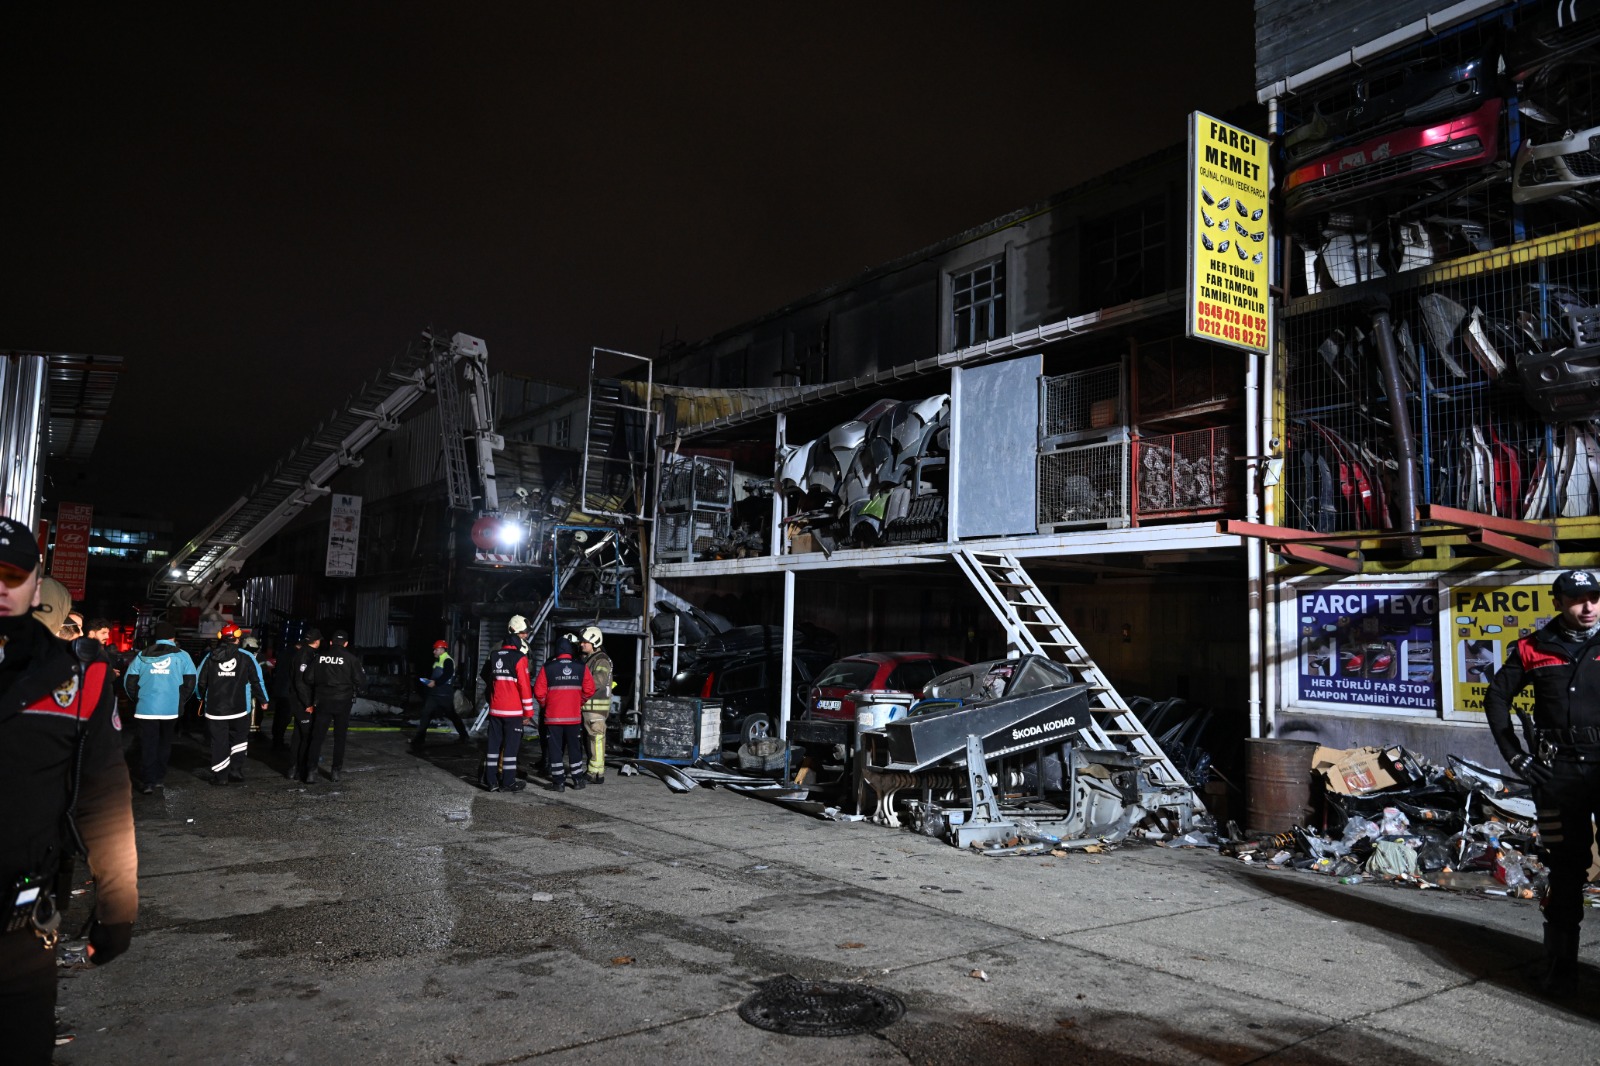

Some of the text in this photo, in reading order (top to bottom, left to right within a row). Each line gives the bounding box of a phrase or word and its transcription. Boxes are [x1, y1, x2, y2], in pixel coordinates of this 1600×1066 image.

[1210, 121, 1256, 157] FARCI
[1205, 144, 1260, 182] MEMET
[1235, 180, 1251, 193] YEDEK
[1210, 259, 1255, 282] HER TÜRLÜ
[1206, 273, 1258, 298] FAR TAMPON
[1200, 285, 1265, 314] TAMİRİ YAPILIR
[1198, 300, 1266, 332] 0545 473 40 52
[1198, 317, 1221, 336] 0212
[1223, 324, 1240, 341] 485
[1255, 332, 1266, 348] 27
[1301, 594, 1439, 615] FARCI TEYO
[1456, 590, 1539, 613] FARCI
[1304, 689, 1348, 701] TAMPON
[1350, 692, 1389, 704] TAMİRİ
[1311, 678, 1430, 694] HER TÜRLÜ FAR STOP
[1471, 686, 1488, 696] HE
[1043, 716, 1076, 732] KODIAQ
